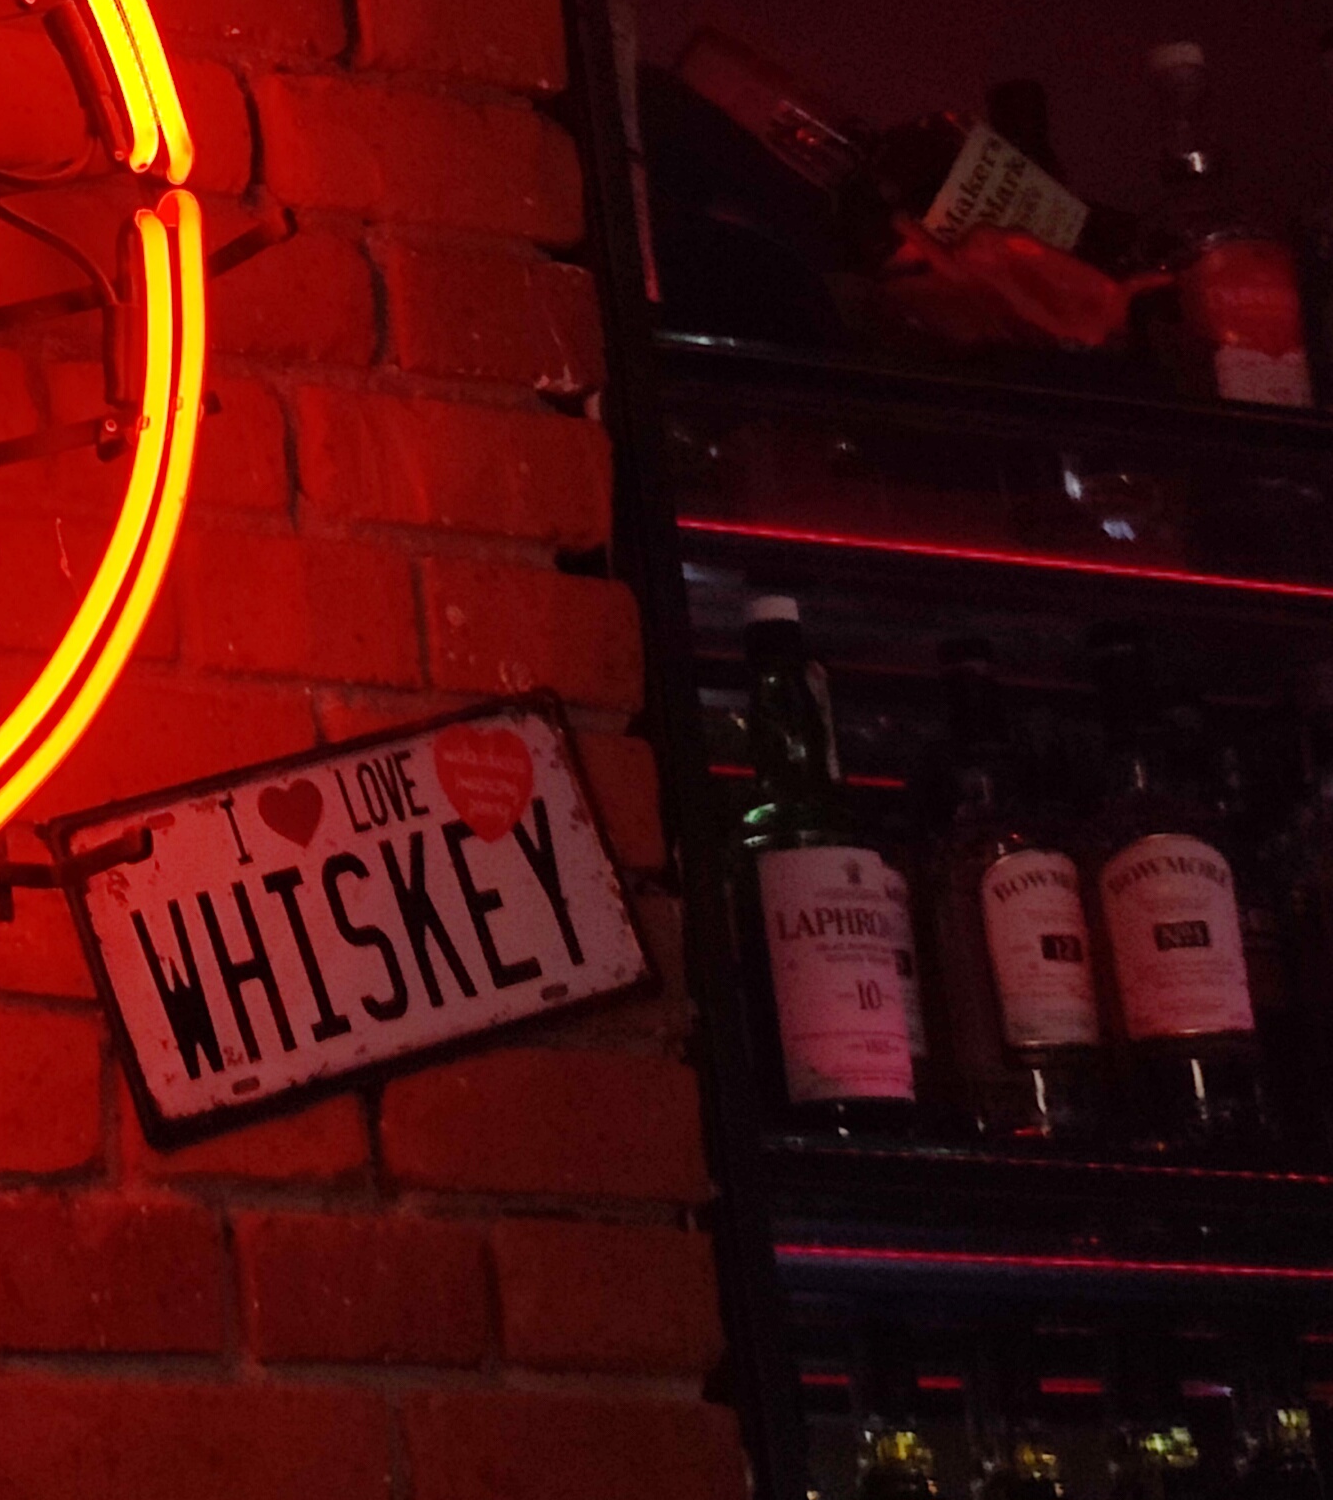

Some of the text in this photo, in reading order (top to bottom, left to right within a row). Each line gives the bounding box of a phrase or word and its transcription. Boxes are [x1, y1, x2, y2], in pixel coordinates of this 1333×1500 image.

[218, 750, 430, 866] I LOVE
[130, 796, 585, 1080] WHISKEY
[857, 980, 882, 1010] 10
